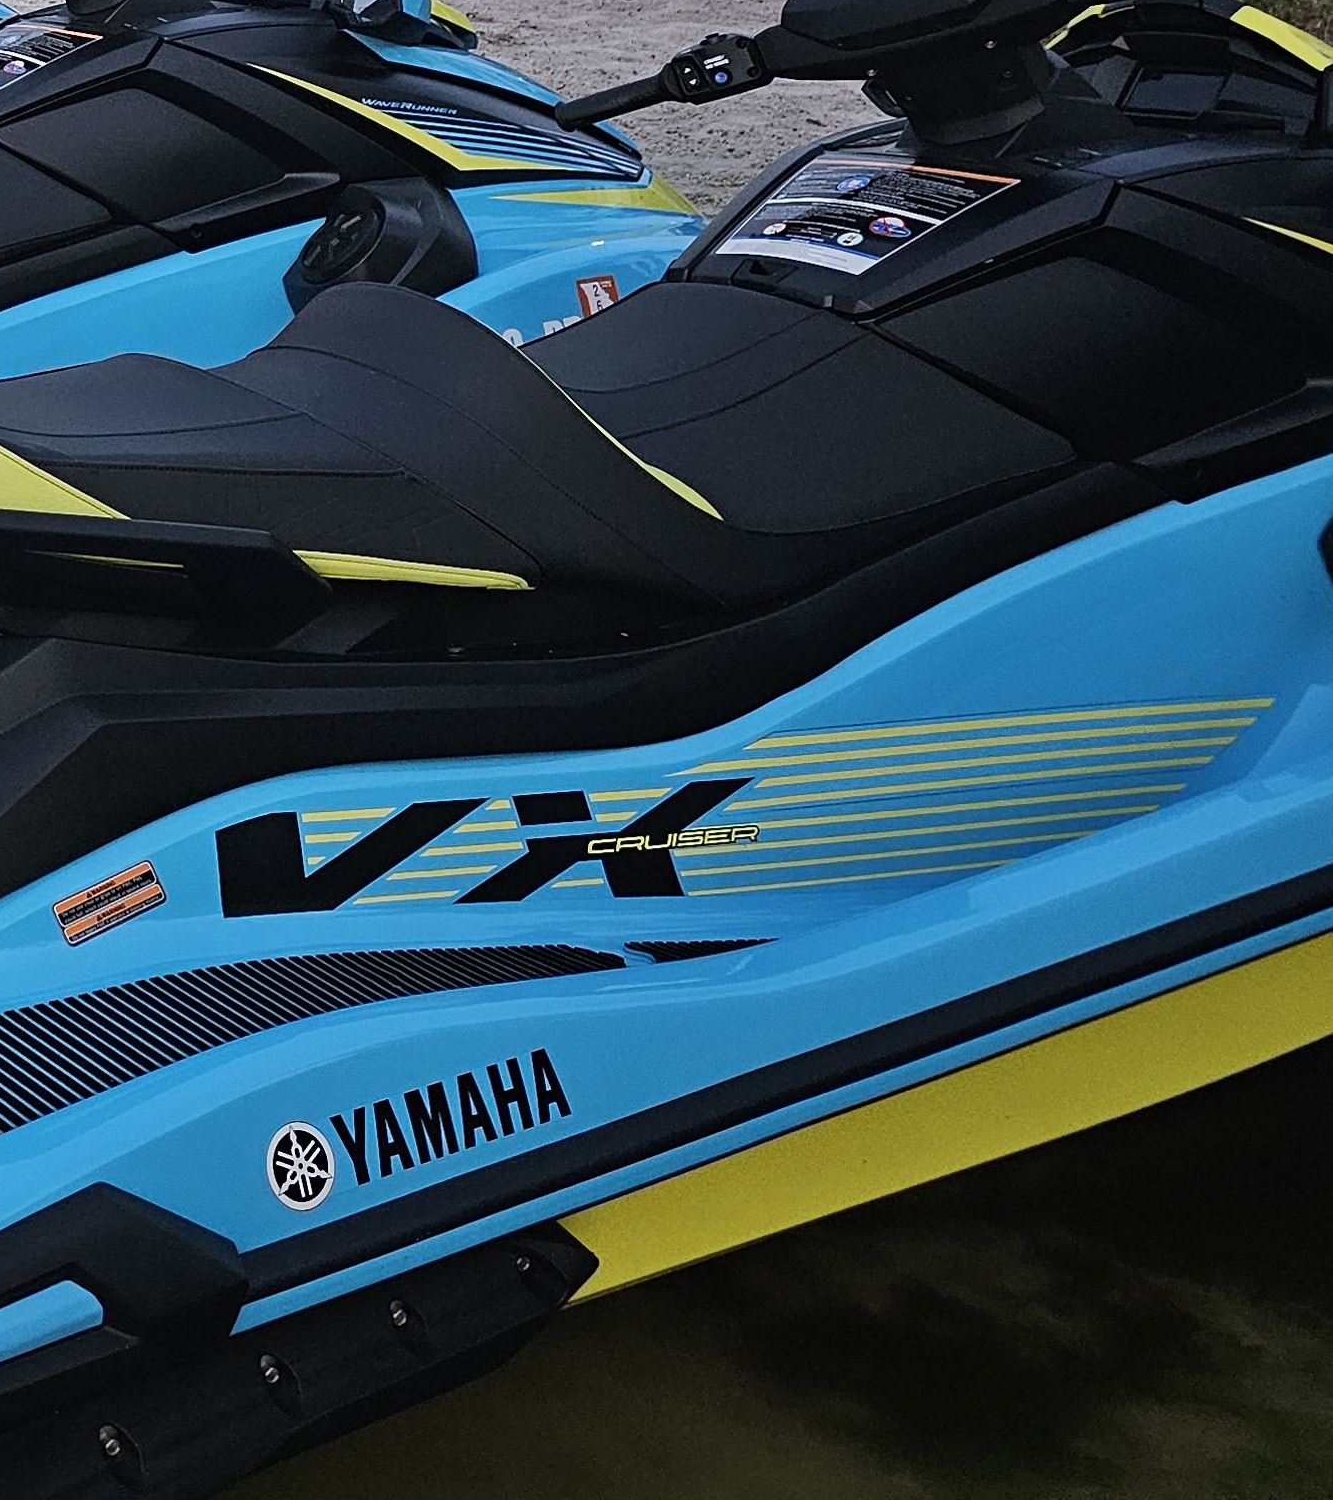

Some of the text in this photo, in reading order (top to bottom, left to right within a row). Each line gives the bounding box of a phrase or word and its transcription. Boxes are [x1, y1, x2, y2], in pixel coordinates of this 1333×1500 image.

[361, 98, 458, 115] WAVERUNNER
[214, 777, 756, 919] VX
[587, 823, 760, 854] CRUISER
[329, 1047, 572, 1186] YAMAHA
